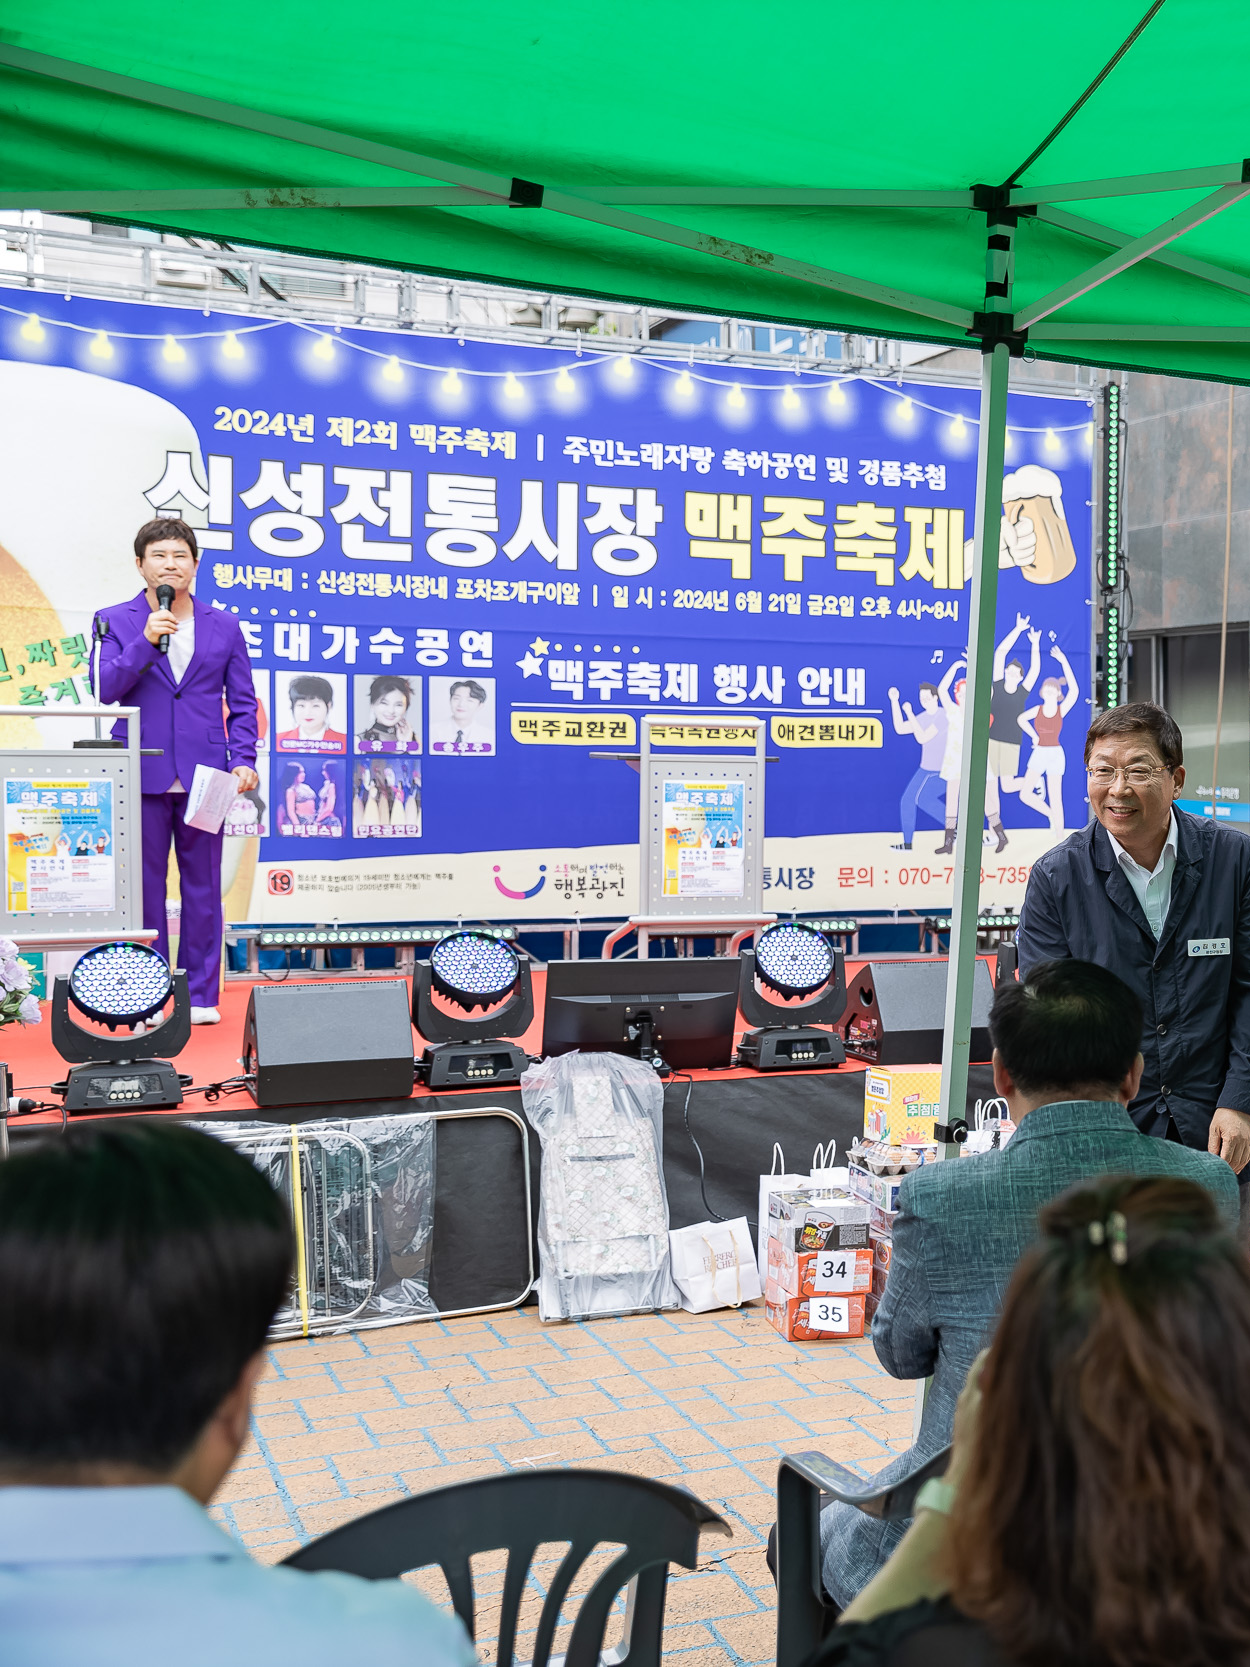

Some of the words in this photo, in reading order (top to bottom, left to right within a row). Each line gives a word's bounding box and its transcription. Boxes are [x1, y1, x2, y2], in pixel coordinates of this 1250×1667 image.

[213, 405, 315, 443] 2024년
[326, 416, 399, 450] 제2회
[408, 422, 518, 460] 맥주축제
[562, 435, 716, 475] 주민노래자랑
[722, 447, 817, 482] 축하공연
[824, 456, 849, 484] 및
[857, 458, 947, 491] 경품추첨
[143, 449, 664, 577] 신성전통시장
[684, 489, 966, 591] 맥주축제
[213, 562, 293, 592] 행사무대
[316, 569, 449, 600] 신성전통시장내
[455, 577, 581, 606] 포차조개구이앞
[611, 585, 629, 609] 일
[635, 586, 653, 610] 시
[673, 588, 730, 613] 2024년
[734, 590, 763, 615] 6월
[767, 591, 802, 617] 21일
[806, 593, 855, 619] 금요일
[859, 596, 892, 620] 오후
[896, 598, 960, 622] 4시~8시
[547, 659, 699, 704] 맥주축제
[712, 662, 786, 705] 행사
[797, 665, 866, 706] 안내
[518, 719, 628, 739] 맥주교환권
[777, 724, 875, 742] 애견뽐내기
[21, 790, 99, 808] 맥주축제
[675, 791, 734, 806] 맥주축제
[271, 874, 291, 891] 19
[554, 876, 625, 900] 행복광진
[837, 866, 875, 888] 문의
[822, 1261, 848, 1279] 34
[818, 1304, 843, 1323] 35
